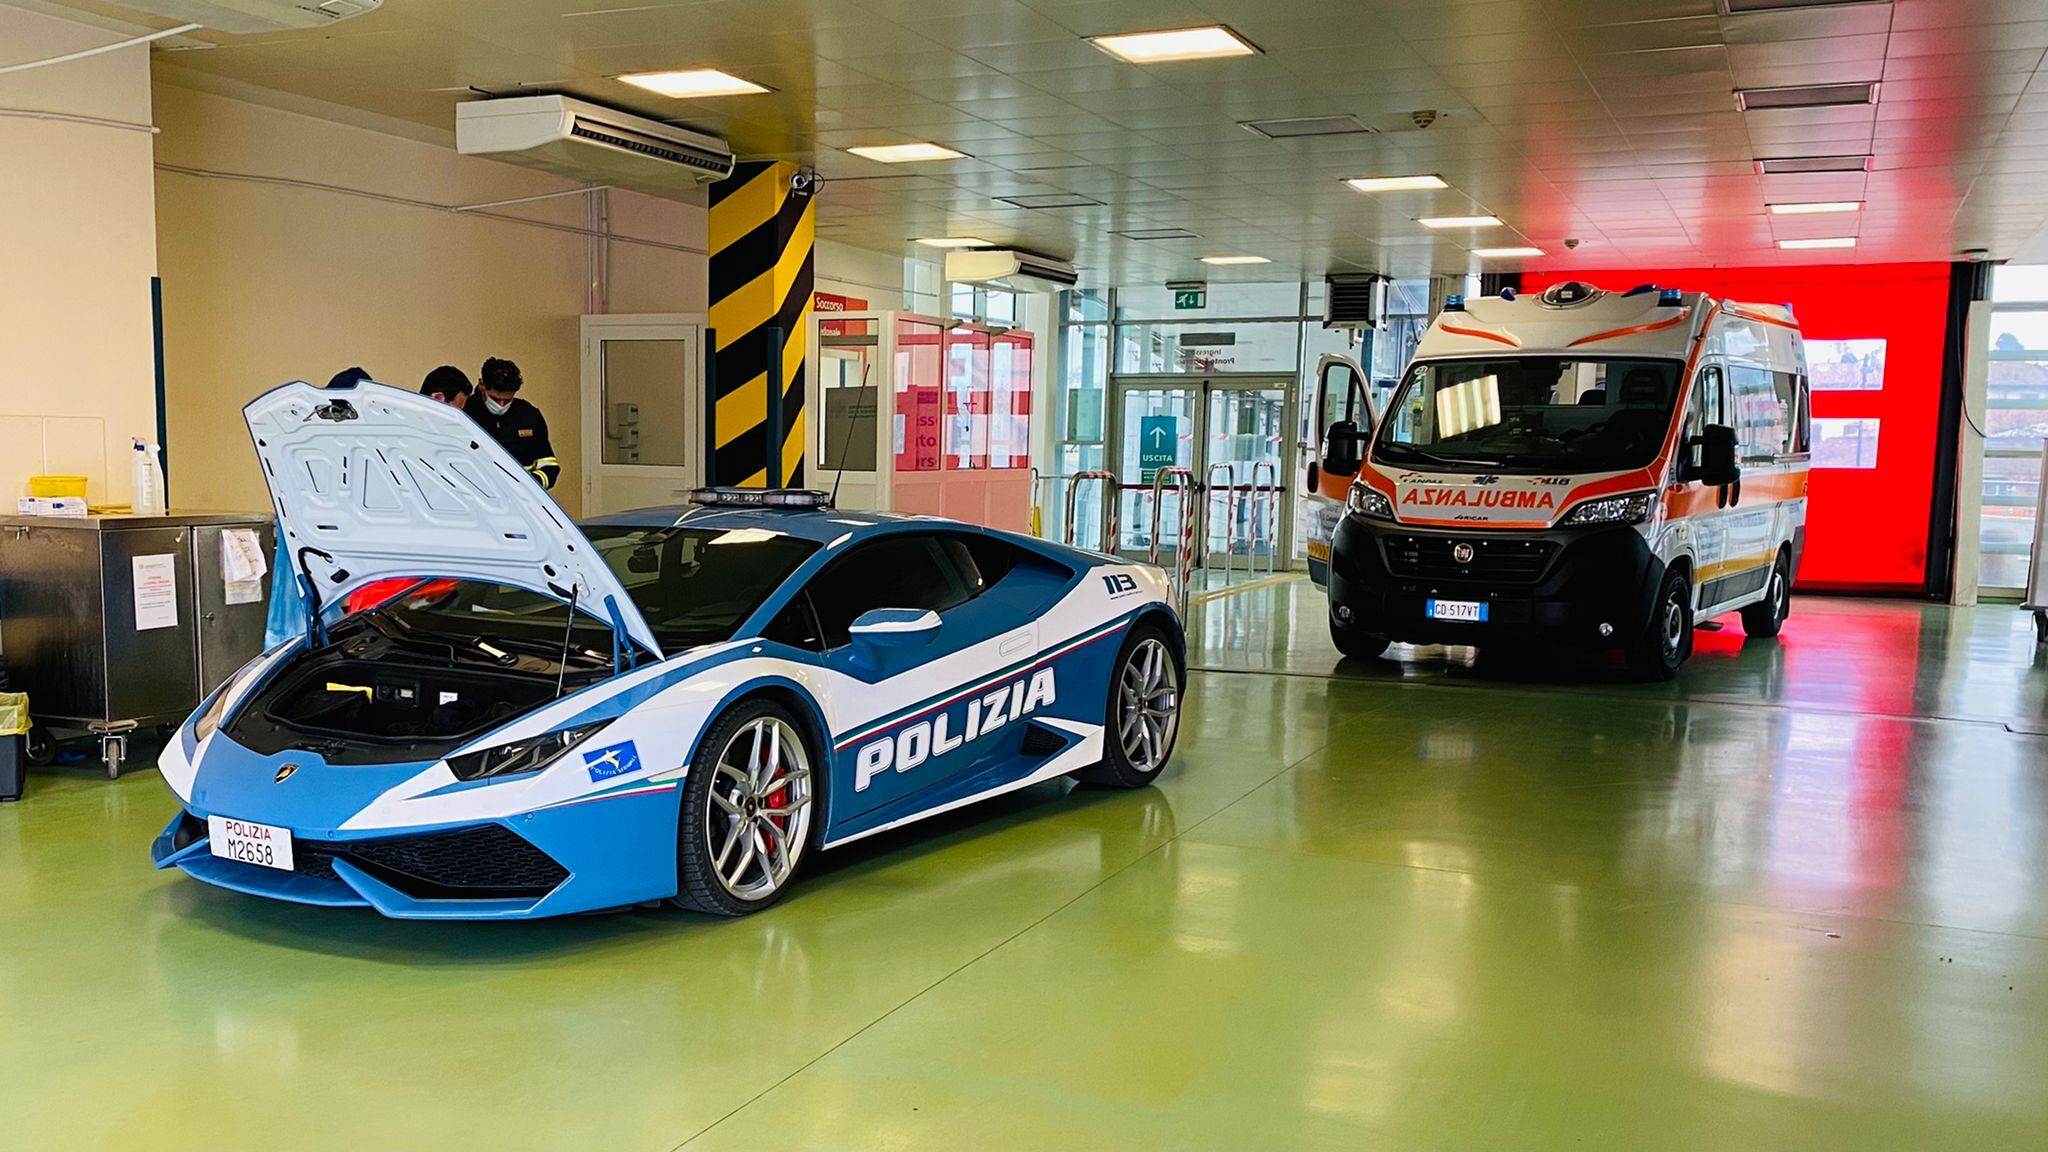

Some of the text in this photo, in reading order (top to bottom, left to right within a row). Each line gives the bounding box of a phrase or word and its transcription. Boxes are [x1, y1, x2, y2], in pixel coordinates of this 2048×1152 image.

[816, 296, 844, 311] Soccorso
[1142, 454, 1173, 462] USCITA
[1102, 574, 1137, 595] 113
[855, 666, 1056, 793] POLIZIA
[225, 820, 272, 841] POLIZIA
[227, 838, 274, 866] M2658
